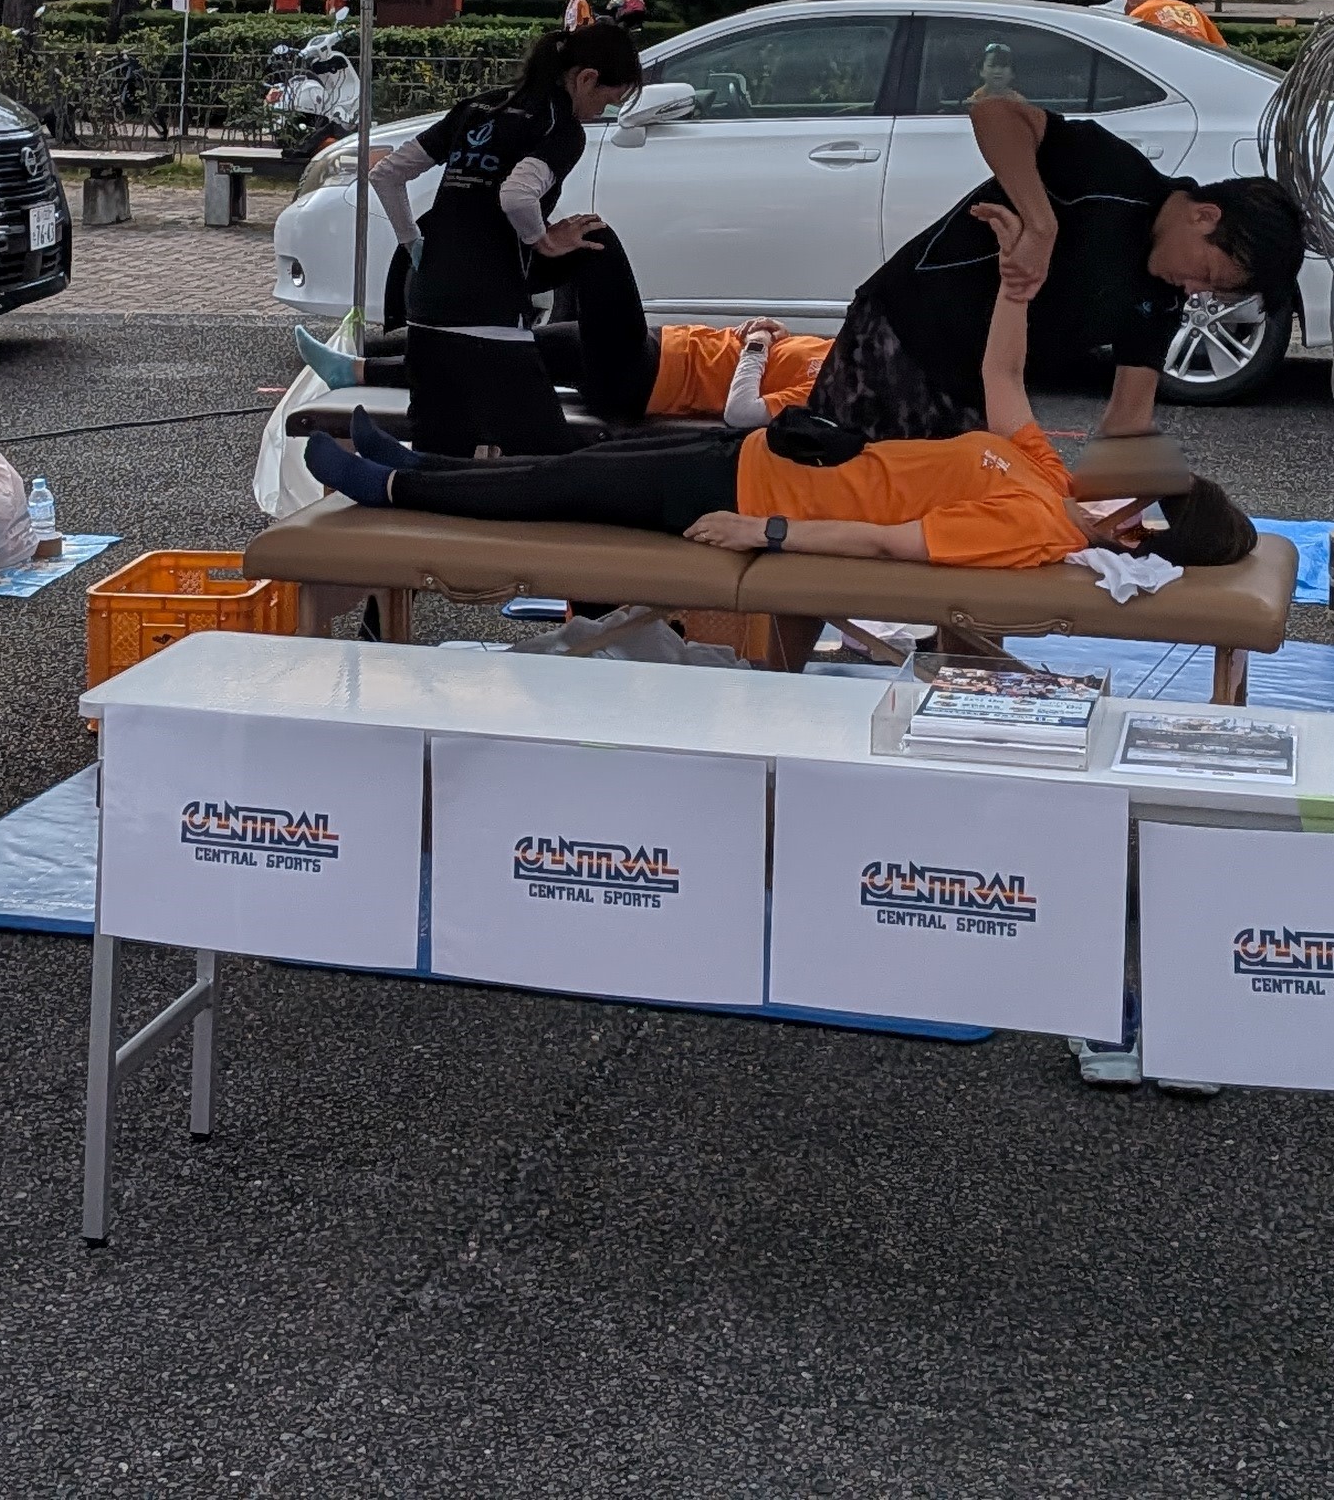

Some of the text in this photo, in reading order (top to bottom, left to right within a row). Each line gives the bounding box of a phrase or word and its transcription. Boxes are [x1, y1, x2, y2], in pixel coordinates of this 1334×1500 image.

[194, 846, 322, 874] CENTRAL SPORTS
[528, 883, 662, 909] CENTRAL SPORTS
[876, 909, 1018, 938] CENTRAL SPORTS
[1251, 977, 1326, 997] CENTRAL
